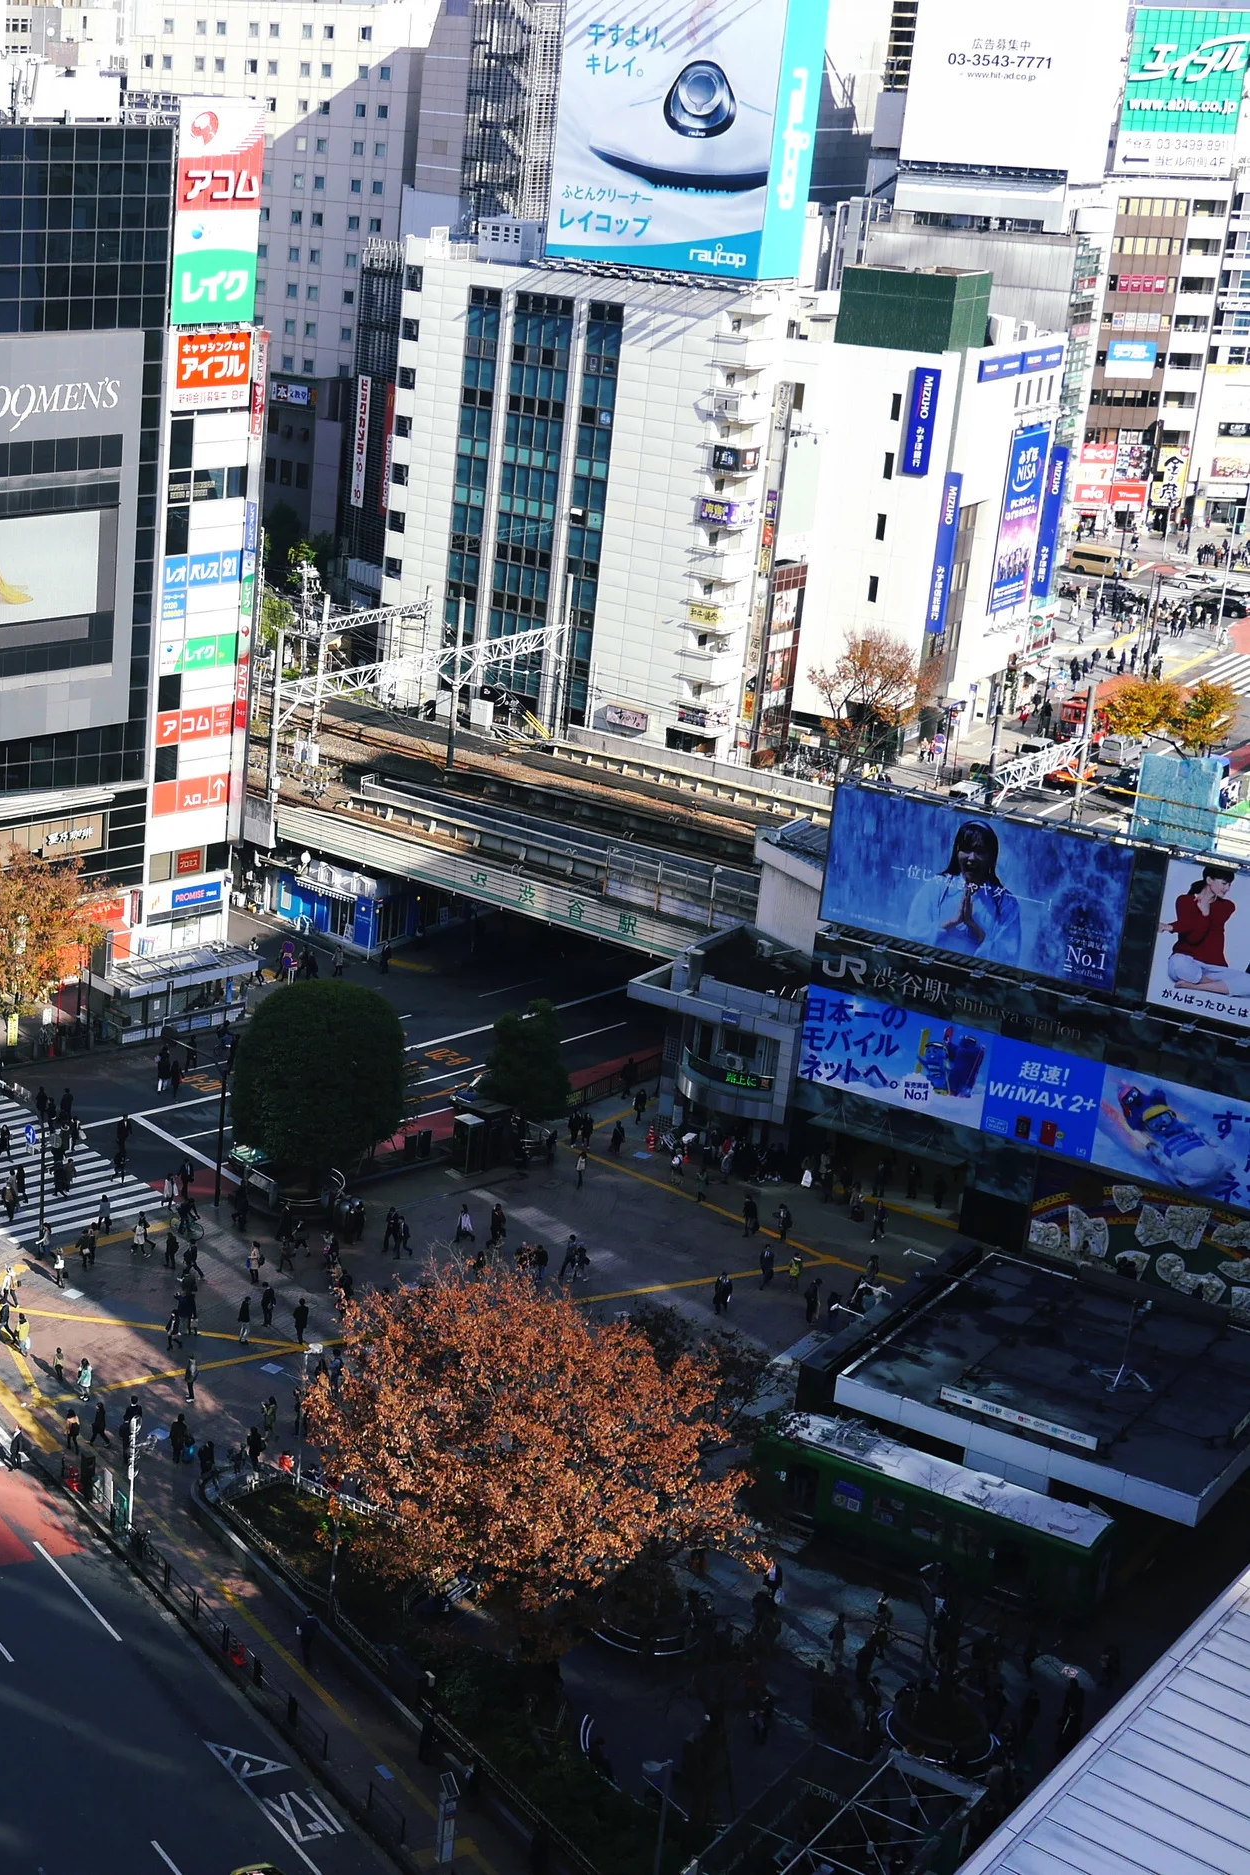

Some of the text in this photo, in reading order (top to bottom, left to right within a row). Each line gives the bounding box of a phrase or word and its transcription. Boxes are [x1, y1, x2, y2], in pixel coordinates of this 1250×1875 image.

[587, 23, 667, 50] 干すより、
[971, 38, 1031, 52] 広告募集中
[586, 53, 645, 78] キレイ。
[947, 52, 1052, 70] 03-3543-7771
[967, 72, 1036, 82] www.hit-ad.co.jp
[1128, 97, 1236, 116] www.able.co.jp
[186, 169, 260, 200] アコム
[561, 184, 654, 206] ふとんクリーナー
[558, 208, 652, 238] レイコップ
[689, 243, 746, 269] raycop
[181, 270, 249, 303] レイク
[181, 340, 246, 353] キャッシングなら
[181, 354, 246, 381] アイフル
[919, 375, 935, 419] MIZUHO
[253, 396, 262, 434] アイフル
[356, 379, 368, 456] ビックカメラ
[912, 426, 925, 468] みずほ銀行
[1016, 466, 1037, 483] NISA
[1051, 460, 1064, 495] MIZUHO
[944, 485, 959, 525] MIZUHO
[165, 556, 238, 584] レオパレス21
[1037, 546, 1050, 583] みずほ銀行
[243, 582, 251, 608] レイク
[185, 645, 215, 662] レイク
[237, 664, 248, 700] アコム
[162, 714, 211, 738] アコム
[182, 792, 202, 807] 入口
[175, 889, 205, 902] PROMISE
[469, 871, 639, 937] JR 渋谷駅
[1065, 944, 1106, 971] No.1
[1073, 966, 1104, 981] SoftBank
[822, 954, 868, 985] JR
[872, 963, 951, 1007] 渋谷駅
[954, 993, 1020, 1025] shibuya
[805, 998, 908, 1030] 日本一の
[801, 1026, 900, 1058] モバイル
[800, 1053, 899, 1090] ネットへ。
[903, 1088, 929, 1101] No.1
[989, 1080, 1097, 1113] WiMAX 2+
